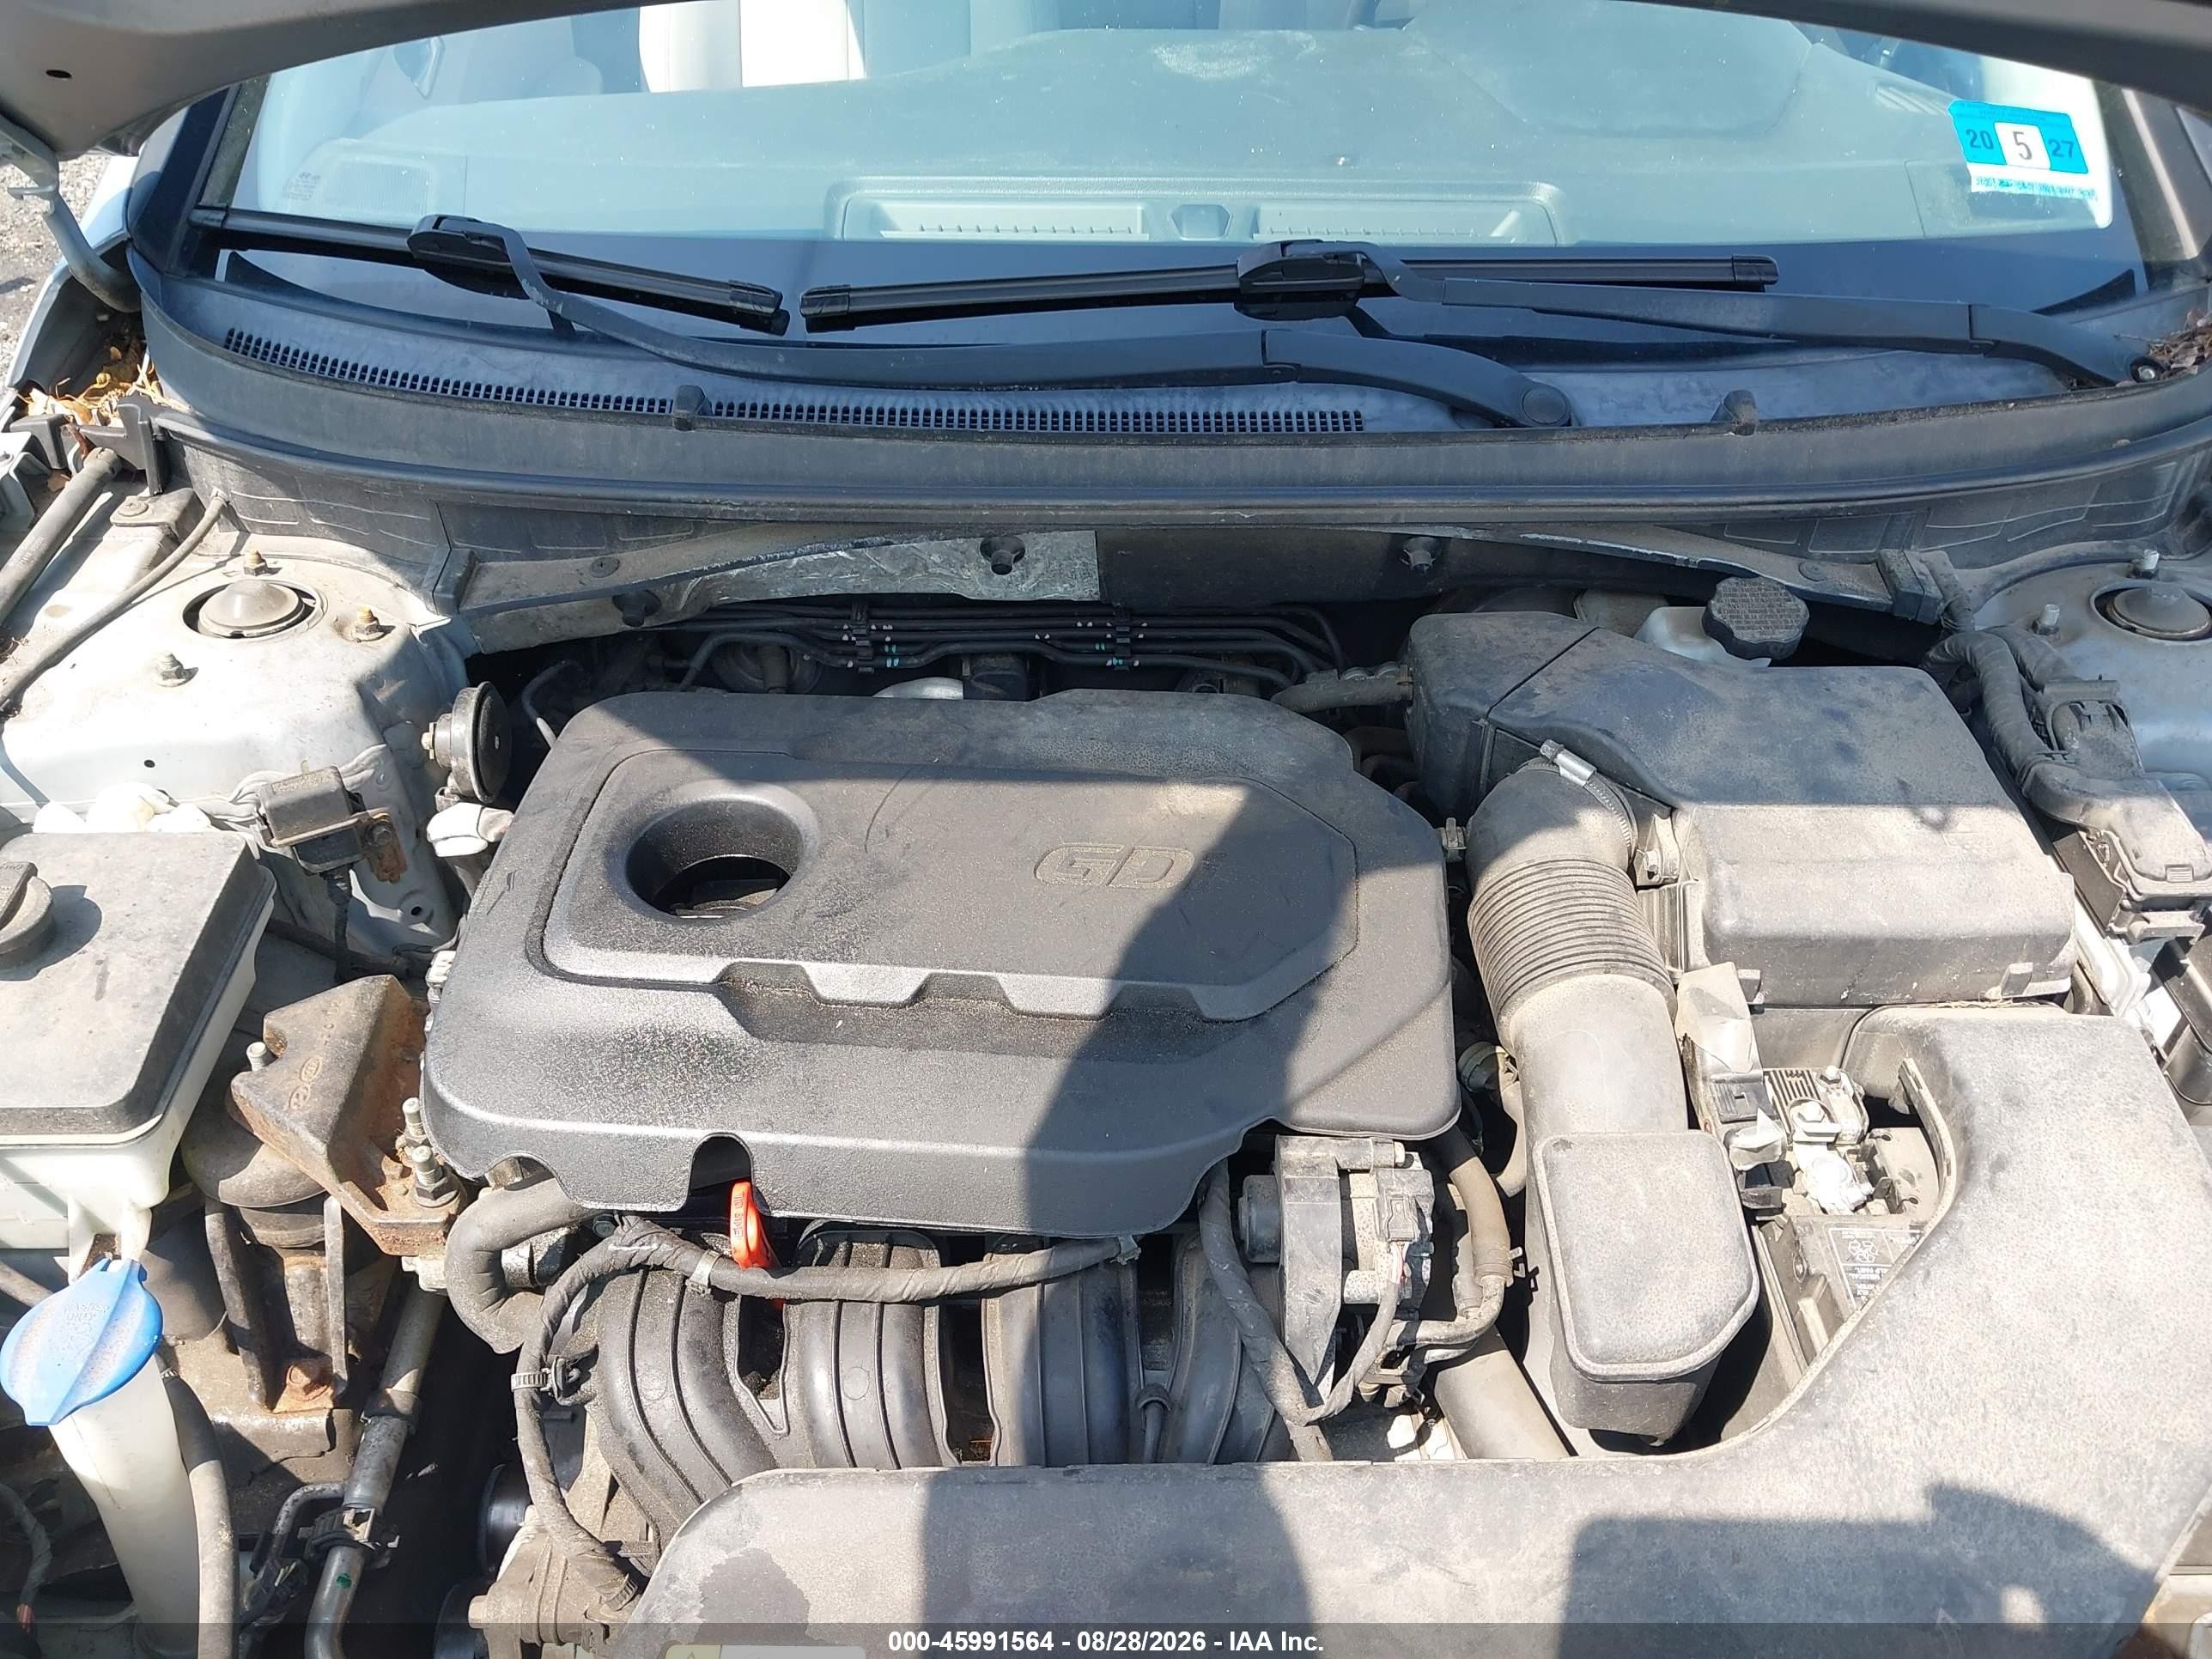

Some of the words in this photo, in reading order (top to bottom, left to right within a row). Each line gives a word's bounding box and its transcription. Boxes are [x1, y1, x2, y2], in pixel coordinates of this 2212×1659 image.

[1966, 128, 1995, 150] 20
[2012, 131, 2033, 161] 5
[2047, 137, 2075, 159] 27
